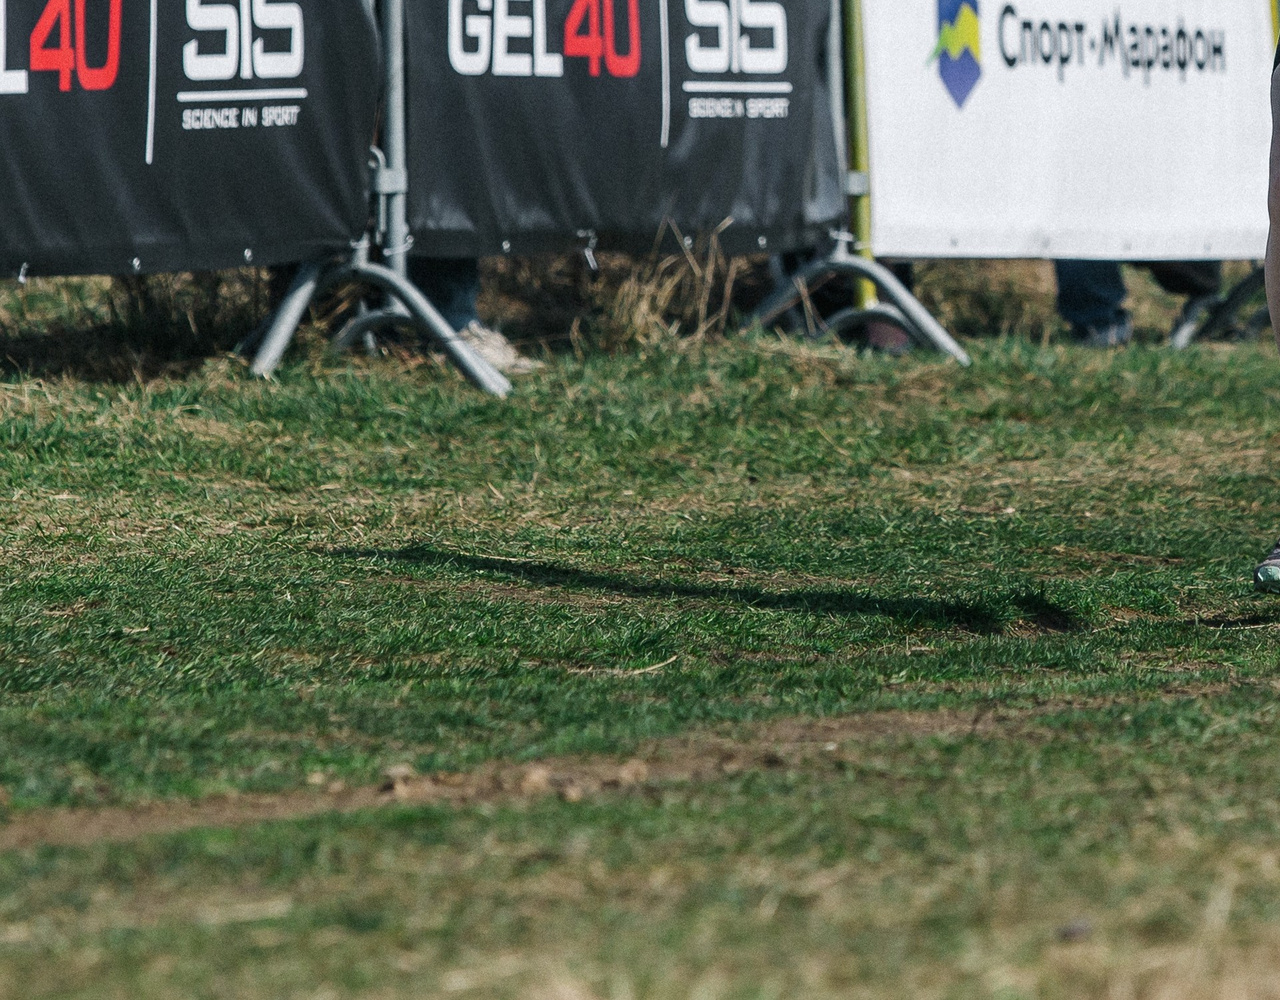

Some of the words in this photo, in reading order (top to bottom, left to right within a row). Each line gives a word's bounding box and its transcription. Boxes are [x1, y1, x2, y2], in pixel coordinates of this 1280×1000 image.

[999, 4, 1226, 84] Спорт-Марафон
[182, 107, 239, 130] SCIENCE
[241, 107, 258, 127] IN
[262, 105, 300, 127] SPORT
